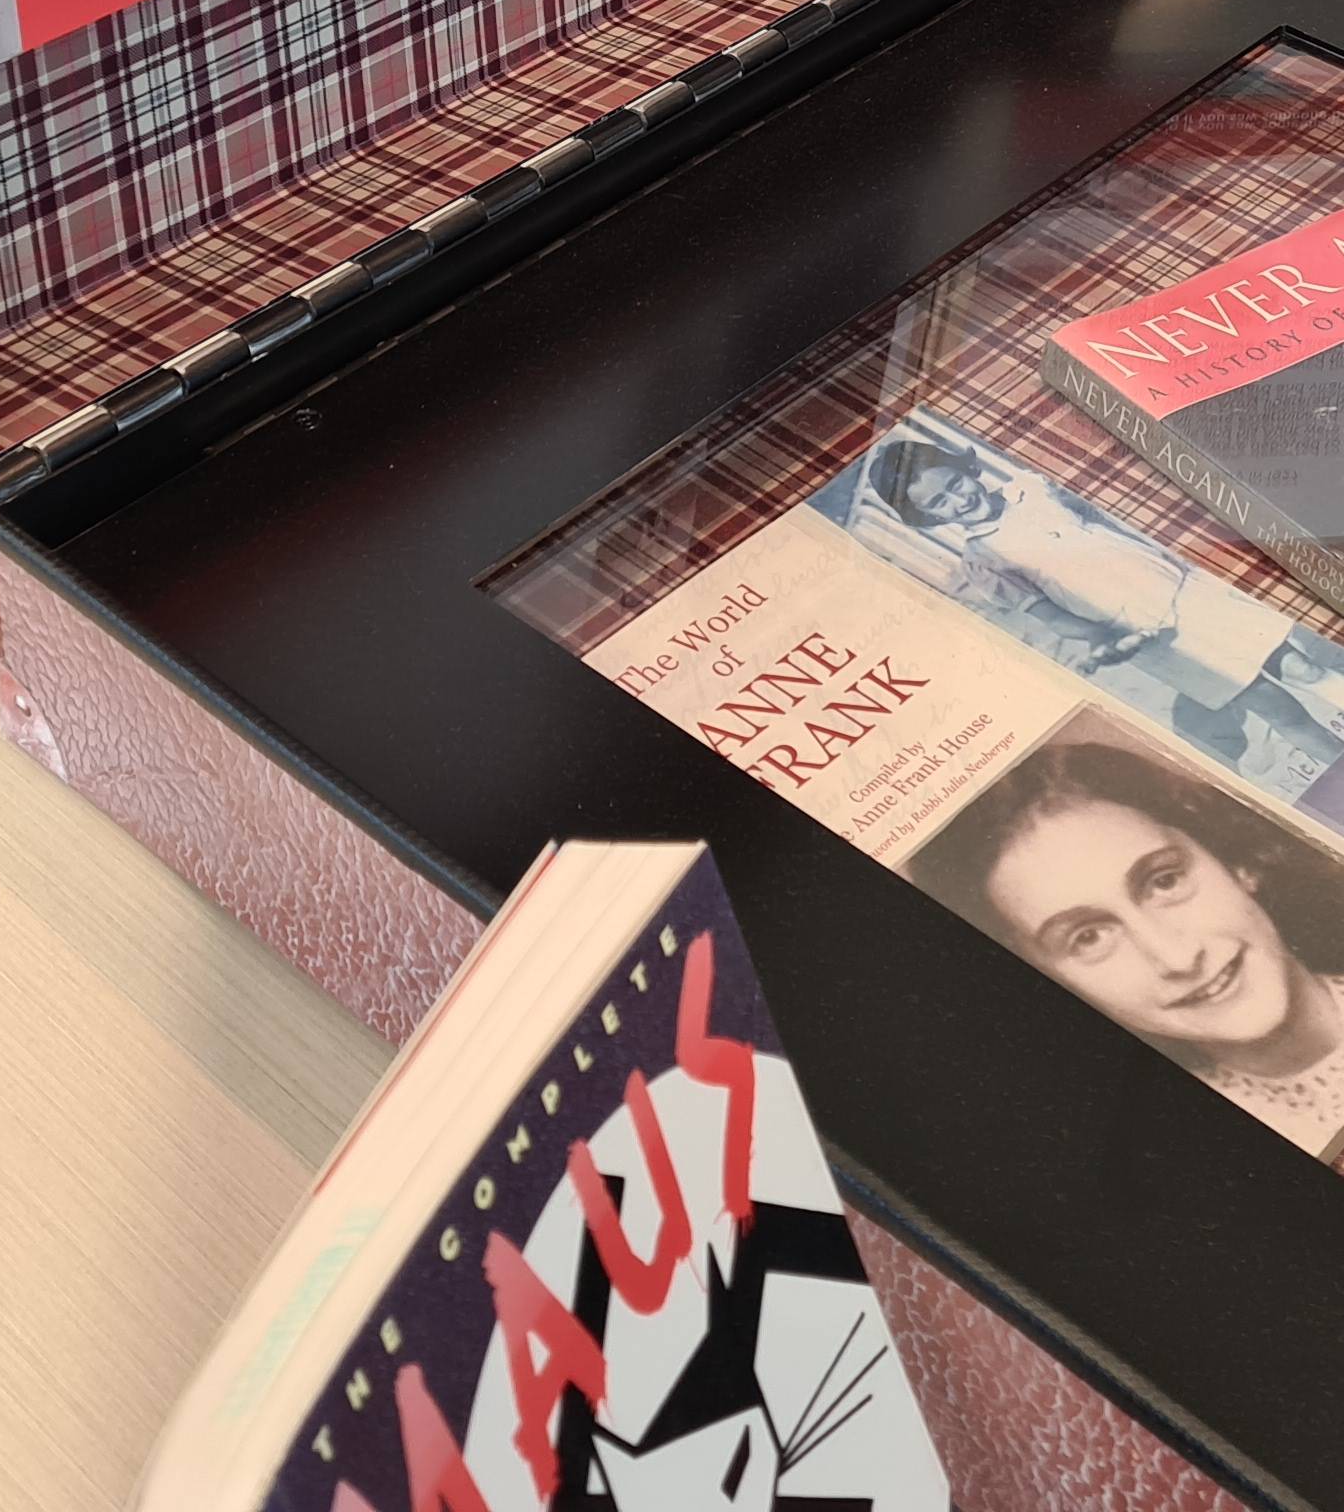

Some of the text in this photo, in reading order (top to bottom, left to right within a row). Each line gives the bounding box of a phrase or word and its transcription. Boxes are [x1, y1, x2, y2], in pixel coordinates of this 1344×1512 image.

[1086, 263, 1340, 380] NEVER
[1146, 384, 1168, 402] A
[1176, 326, 1303, 388] HISTORY
[1063, 365, 1148, 446] NEVER
[1156, 439, 1254, 528] AGAIN
[1256, 526, 1284, 555] THE
[1268, 521, 1278, 534] A
[614, 584, 768, 698] The World
[712, 645, 746, 677] of
[697, 632, 857, 760] ANNE
[848, 740, 926, 803] Compiled by
[851, 712, 994, 833] Anne Frank House
[899, 731, 1017, 834] by Rabbi Julia Neuberger
[312, 923, 679, 1463] THE COMPLETE
